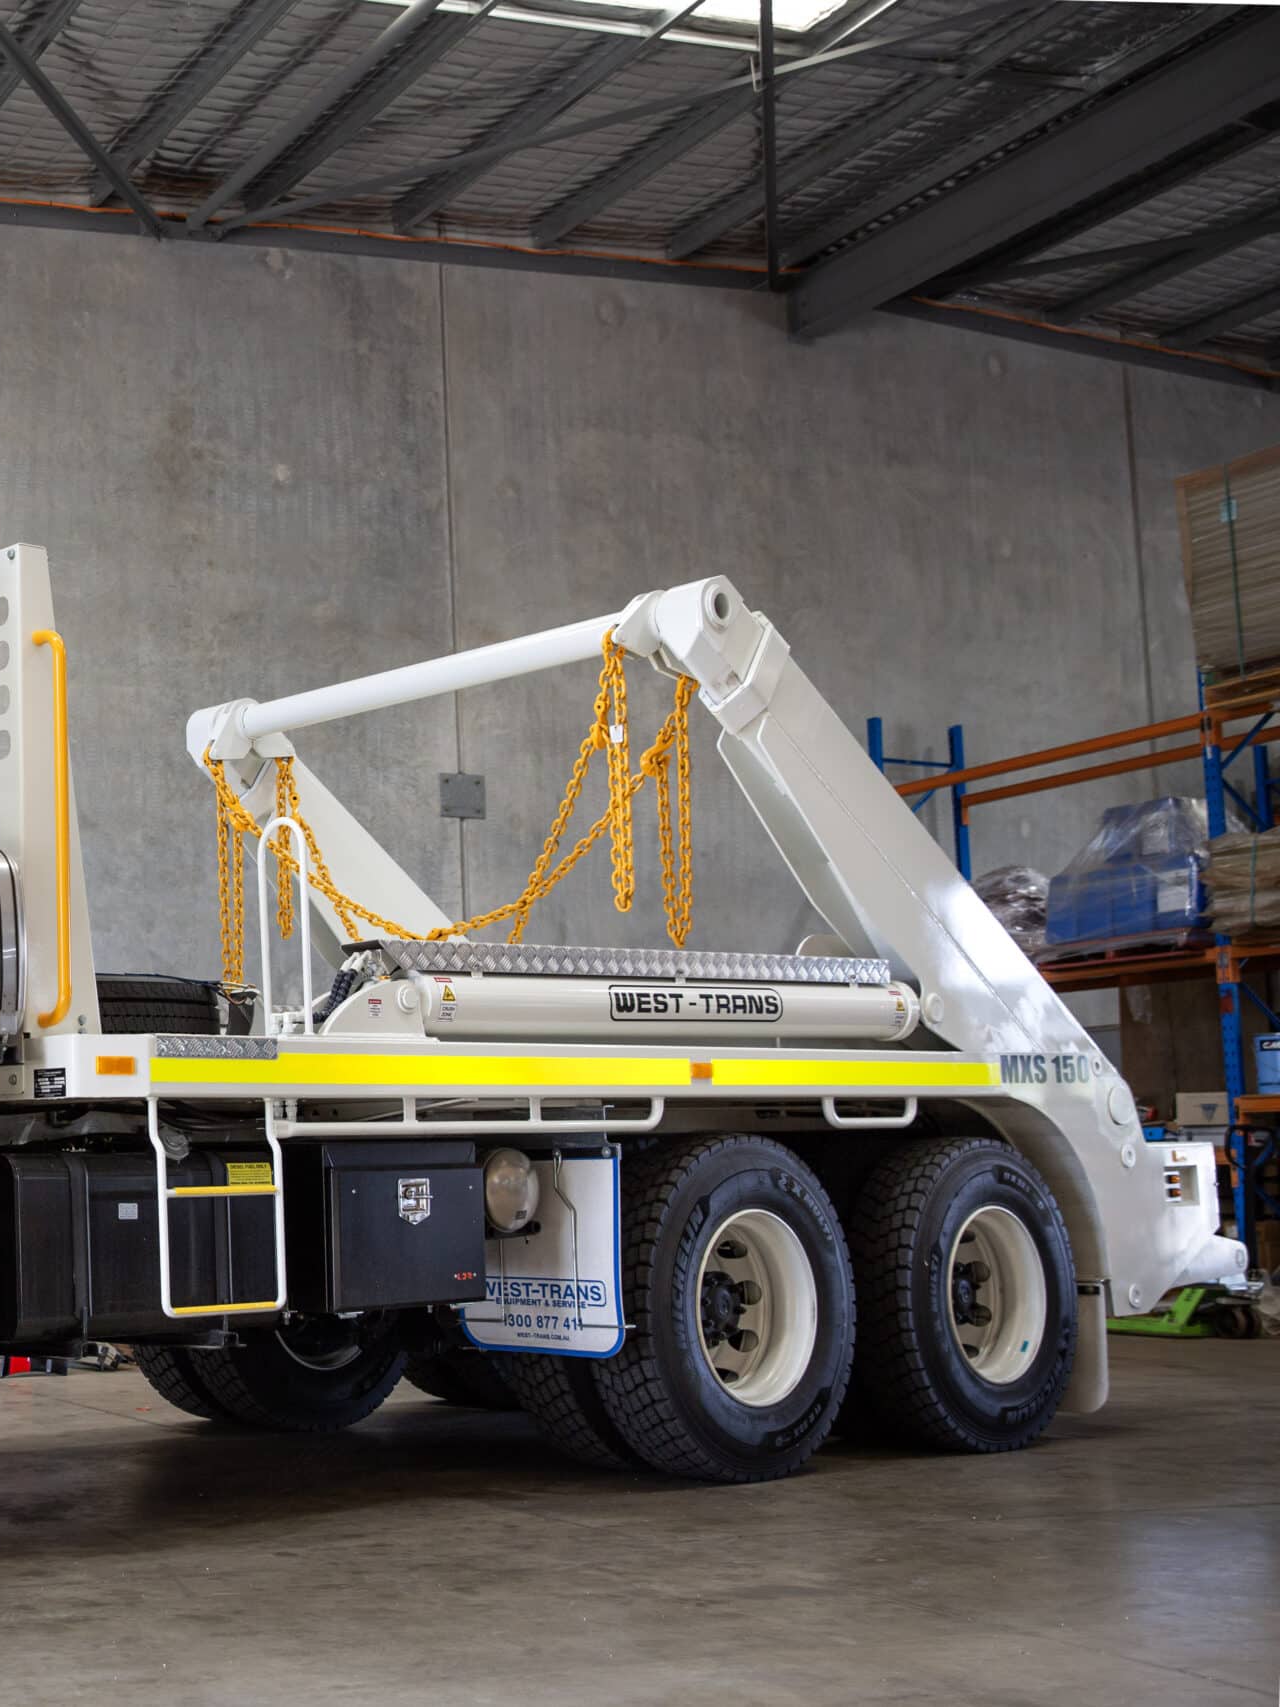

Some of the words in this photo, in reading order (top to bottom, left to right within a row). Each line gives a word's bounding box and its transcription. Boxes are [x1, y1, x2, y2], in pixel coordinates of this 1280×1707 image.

[1000, 1054, 1048, 1084] MXS
[1051, 1055, 1089, 1083] 150
[536, 1316, 558, 1330] 877
